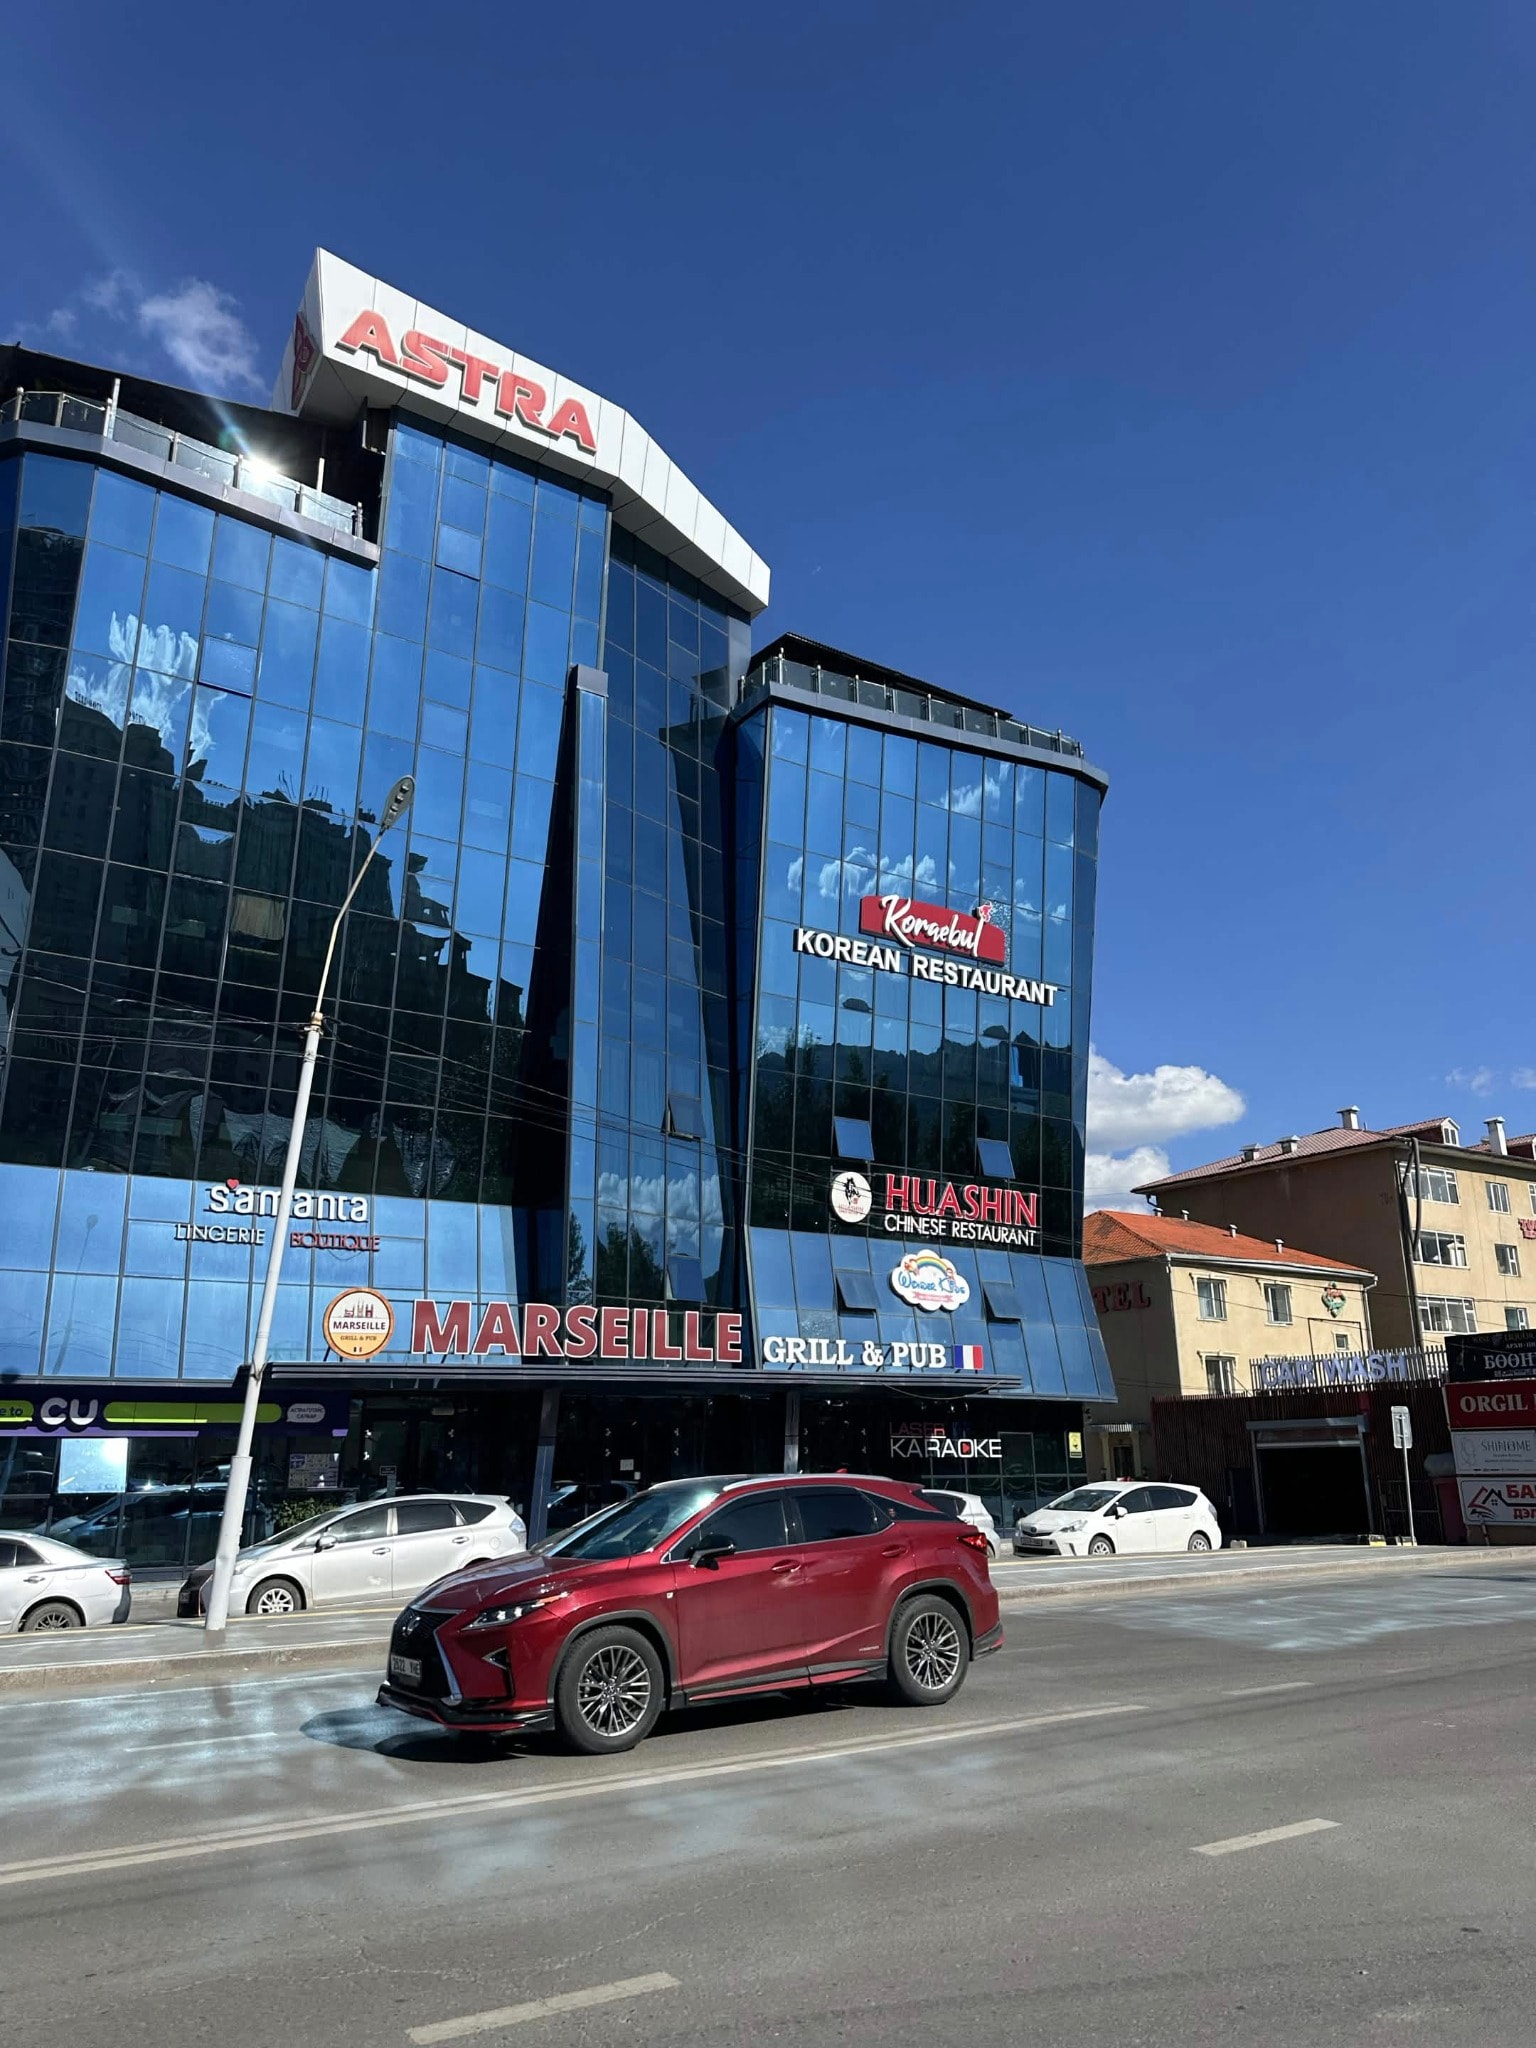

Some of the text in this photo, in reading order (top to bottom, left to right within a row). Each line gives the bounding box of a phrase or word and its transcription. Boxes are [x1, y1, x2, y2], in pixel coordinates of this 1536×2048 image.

[337, 309, 598, 454] ASTRA
[797, 928, 1058, 1007] KOREAN RESTAURANT
[885, 1173, 1038, 1227] HUASHIN
[175, 1223, 380, 1250] LINGERIE BOUTIQUE
[885, 1214, 1037, 1247] CHINESE RESTAURANT
[333, 1321, 386, 1330] MARSEILLE
[411, 1299, 743, 1362] MARSEILLE
[763, 1336, 947, 1369] GRILL & PUB
[1483, 1352, 1536, 1369] БӨӨН
[1260, 1353, 1409, 1387] CAR WASH
[10, 1406, 24, 1416] to
[41, 1397, 98, 1425] CU
[1460, 1394, 1528, 1413] ORGIL
[889, 1421, 947, 1437] LASER
[889, 1438, 1003, 1458] KARAOKE
[1506, 1484, 1536, 1499] БА
